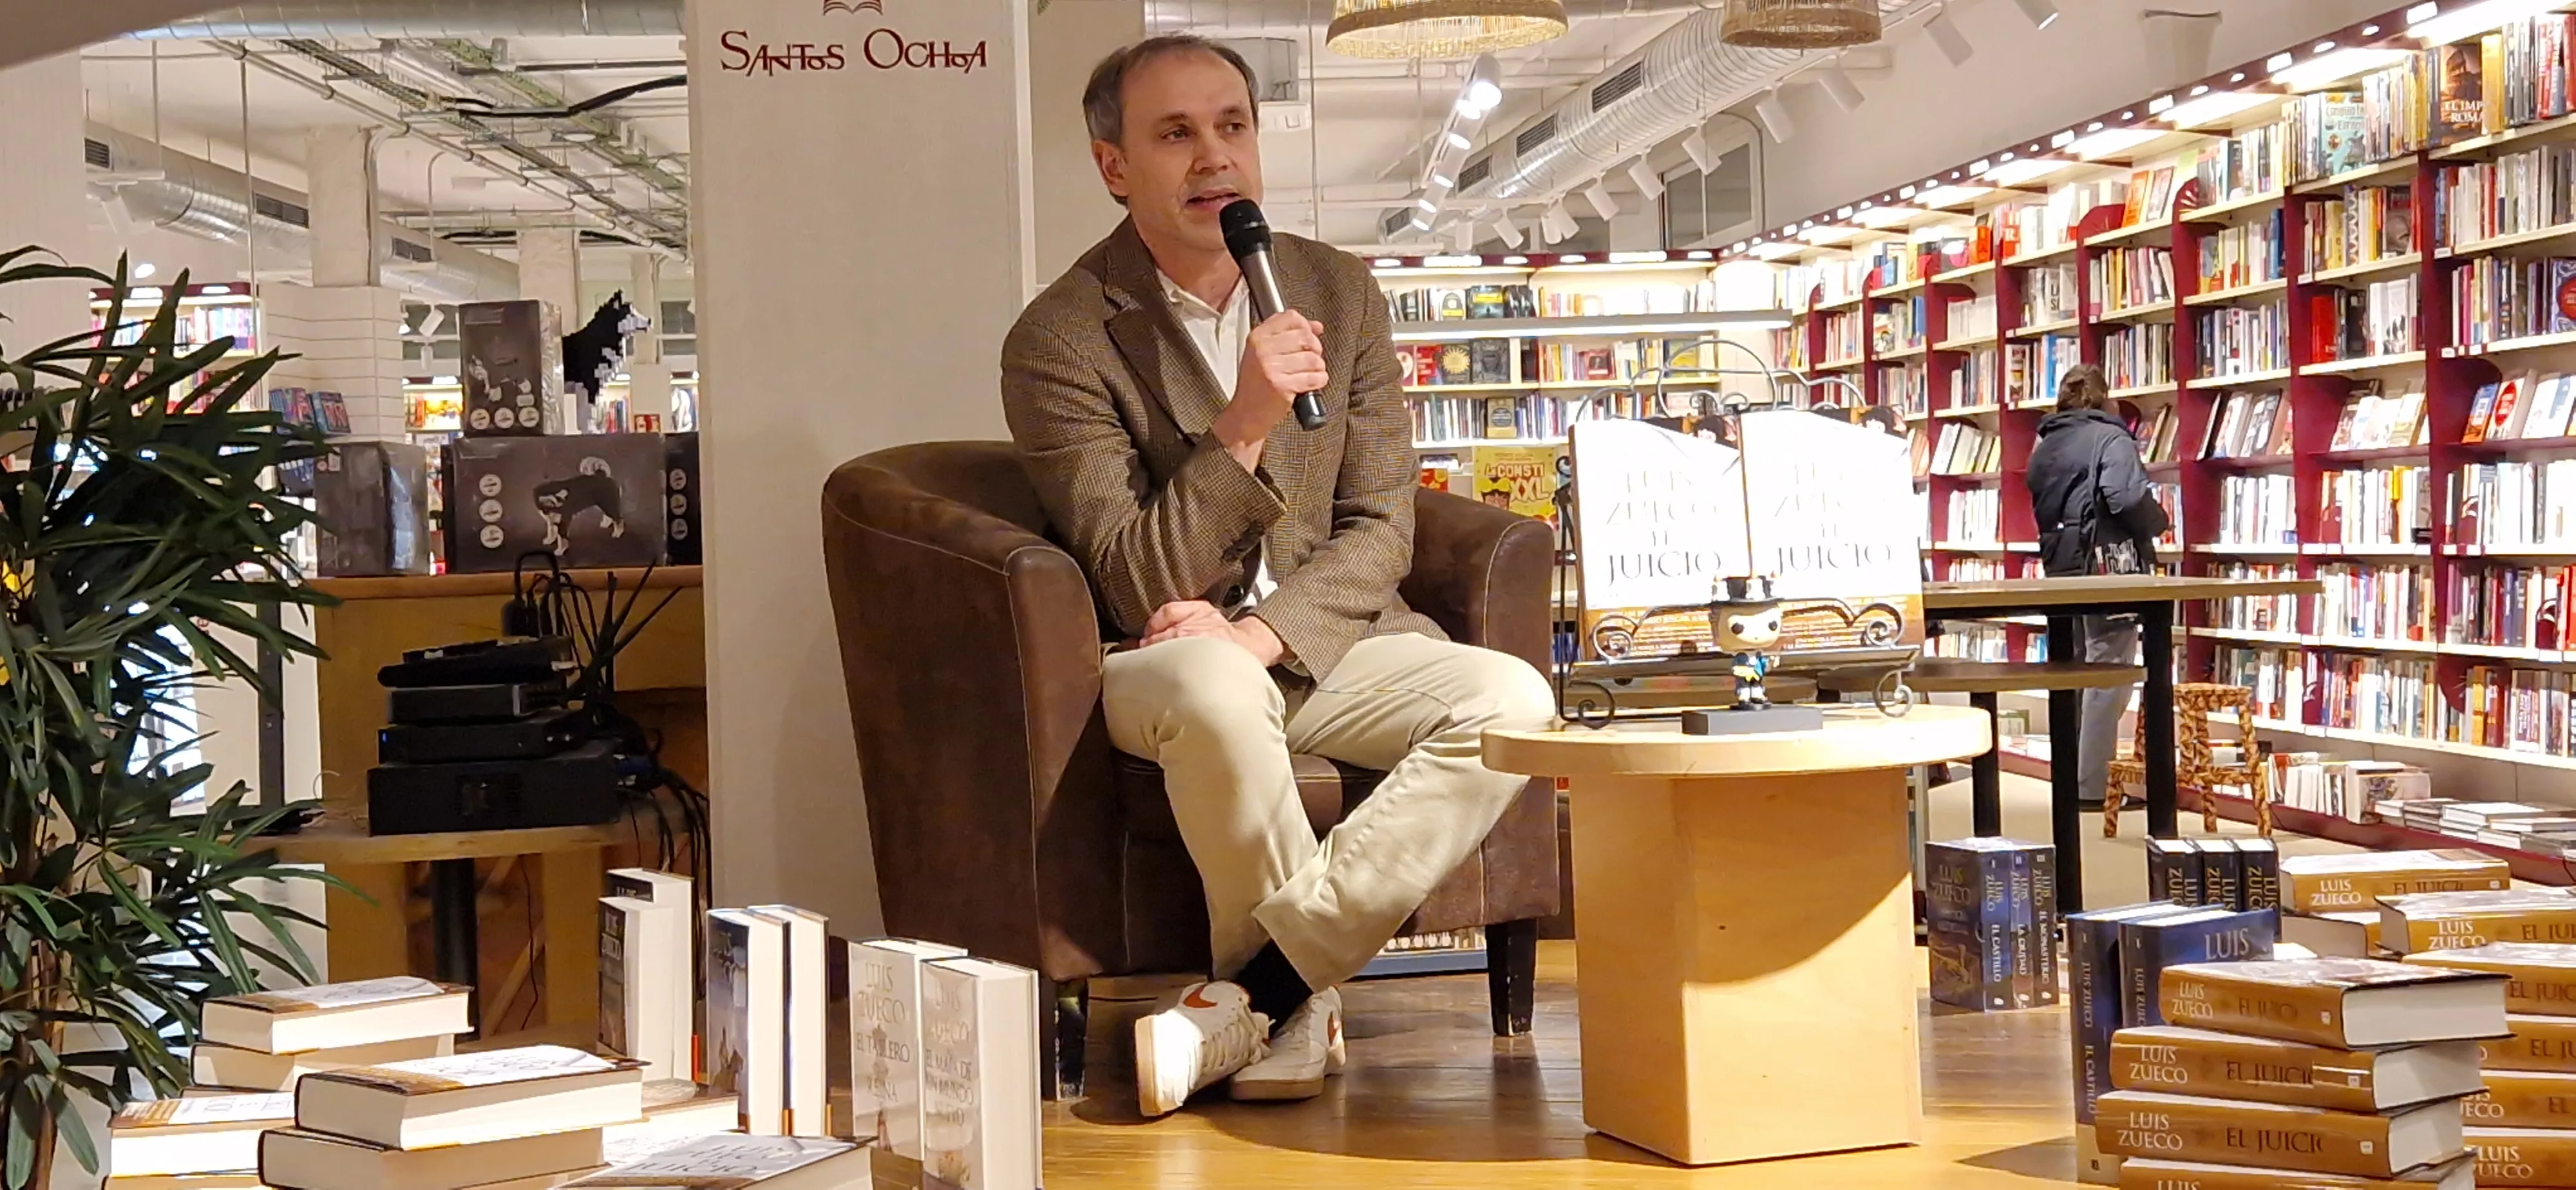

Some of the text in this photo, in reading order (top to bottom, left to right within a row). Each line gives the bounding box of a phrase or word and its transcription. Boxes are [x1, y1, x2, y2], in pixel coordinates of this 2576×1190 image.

[863, 28, 987, 74] OCHOA
[1497, 464, 1544, 477] CONSTI
[1510, 477, 1551, 502] XXL
[1609, 551, 1721, 587] JUICIO
[1778, 543, 1891, 577] JUICIO
[2320, 879, 2351, 892] LUIS
[2392, 882, 2408, 894] EL
[2311, 892, 2362, 906] ZUECO
[2438, 921, 2474, 935] LUIS
[2522, 924, 2538, 940] EL
[2204, 928, 2250, 960] LUIS
[2428, 936, 2486, 950] ZUECO
[2179, 981, 2205, 998] LUIS
[2509, 981, 2530, 998] EL
[2172, 999, 2213, 1019] ZUECO
[2141, 1045, 2177, 1064] LUIS
[2530, 1039, 2553, 1057] EL
[2130, 1063, 2188, 1084] ZUECO
[2226, 1061, 2242, 1081] EL
[2549, 1097, 2570, 1113] EL
[2130, 1111, 2170, 1131] LUIS
[2117, 1129, 2183, 1151] ZUECO
[2226, 1128, 2245, 1148] EL
[2479, 1146, 2521, 1162] LUIS
